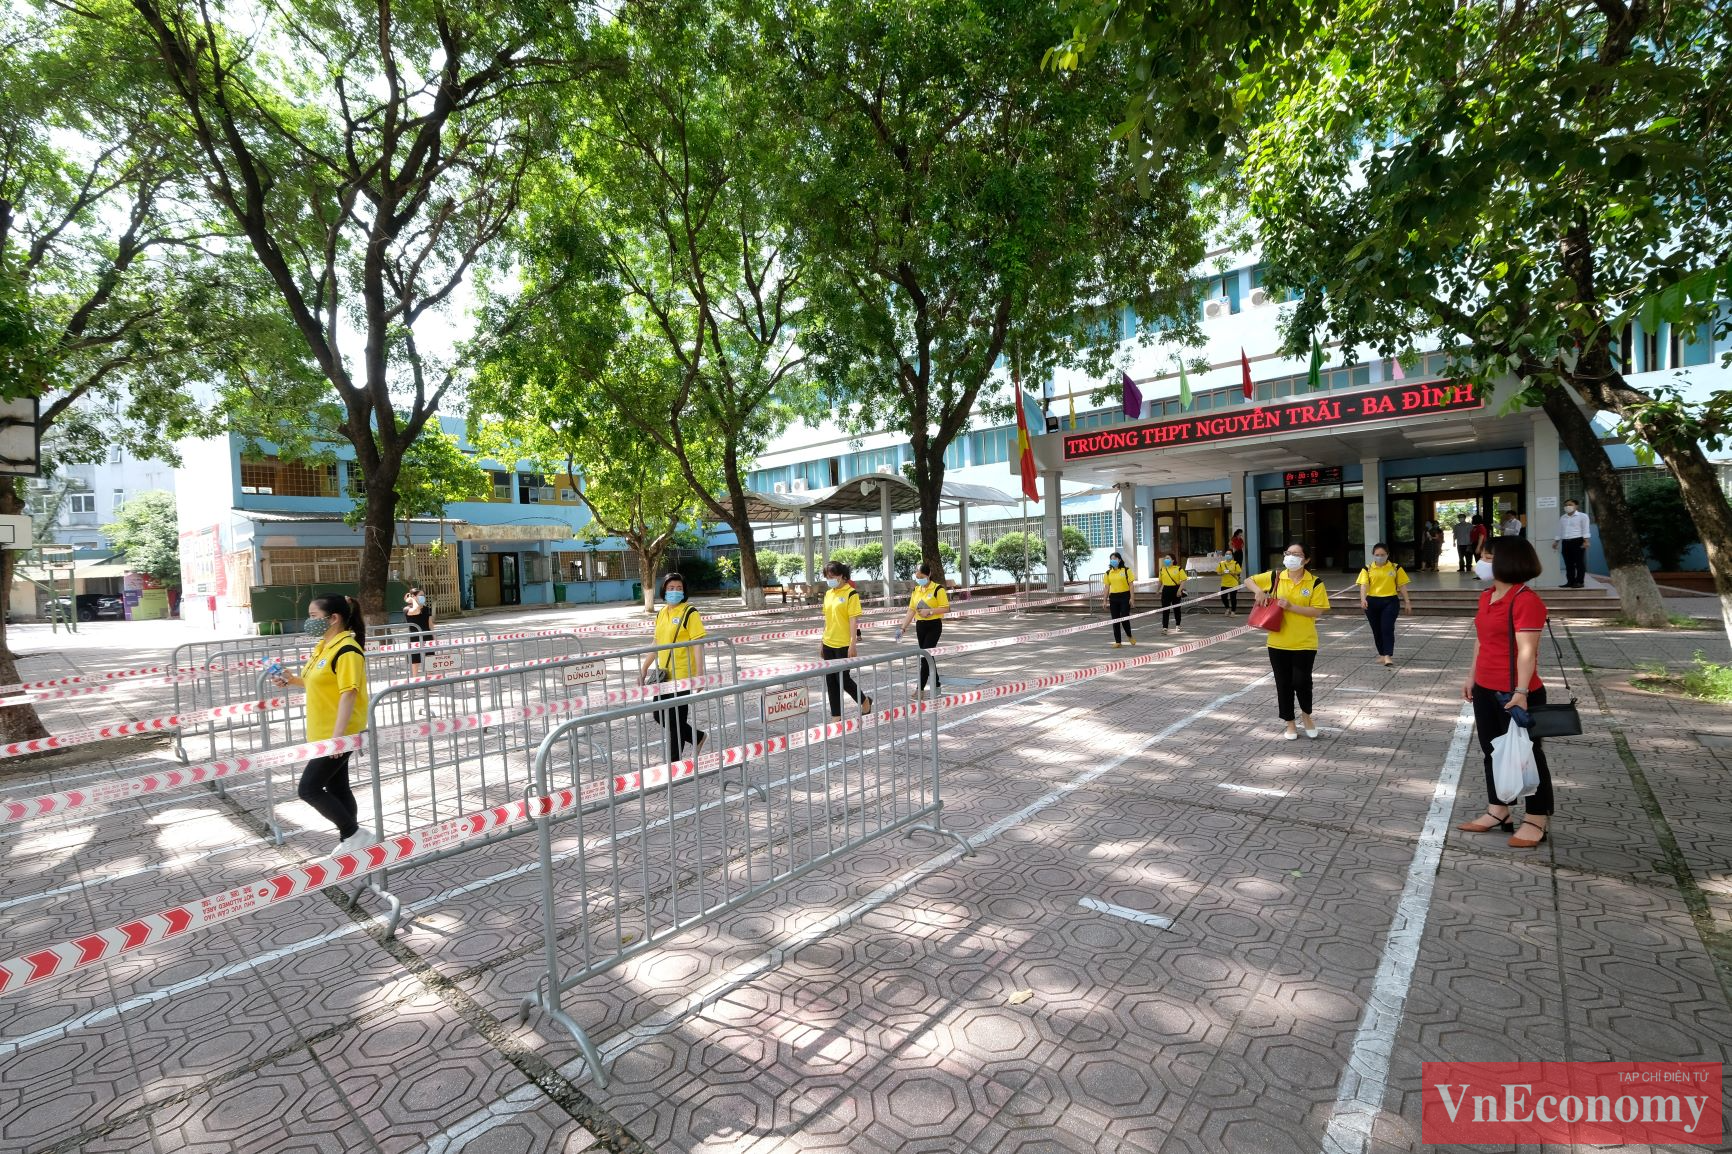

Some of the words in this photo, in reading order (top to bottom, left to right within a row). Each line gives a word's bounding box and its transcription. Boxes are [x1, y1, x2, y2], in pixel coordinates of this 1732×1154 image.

[1067, 431, 1138, 454] TRƯỜNG
[1142, 423, 1192, 445] THPT
[1195, 407, 1280, 437] NGUYỄN
[1286, 400, 1341, 425] TRÃI
[1361, 395, 1396, 415] BA
[432, 660, 454, 669] STOP
[567, 671, 590, 681] DỪNG
[590, 669, 604, 678] LẠI
[768, 701, 792, 715] DỪNG
[793, 698, 807, 709] LẠI
[202, 906, 217, 915] AREA
